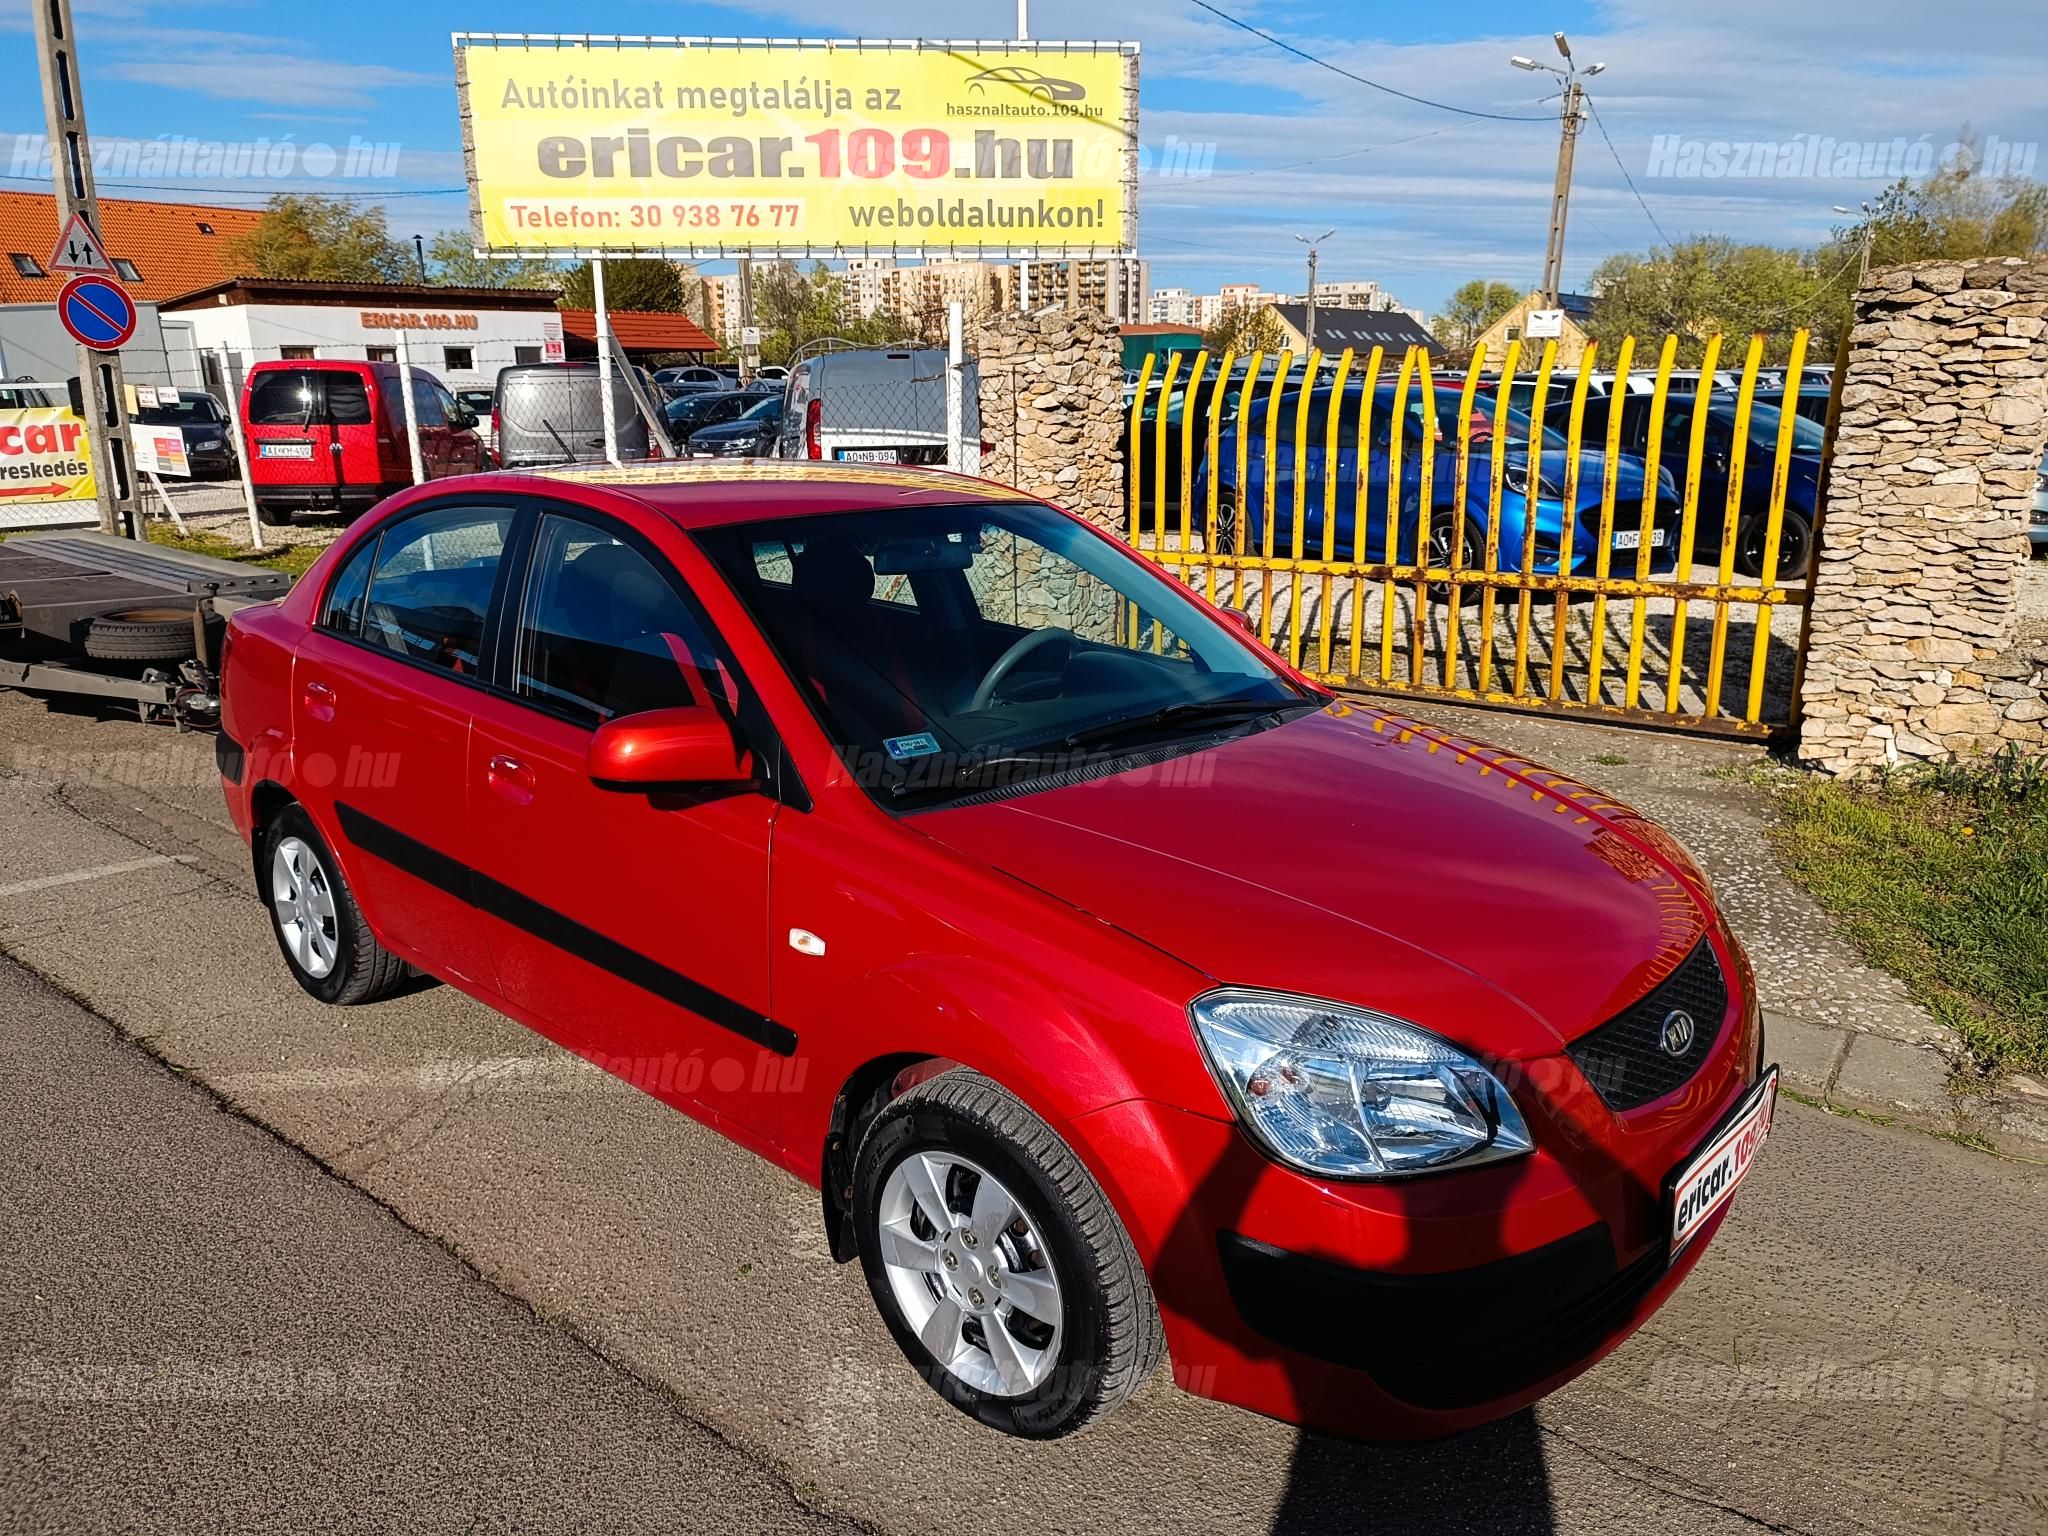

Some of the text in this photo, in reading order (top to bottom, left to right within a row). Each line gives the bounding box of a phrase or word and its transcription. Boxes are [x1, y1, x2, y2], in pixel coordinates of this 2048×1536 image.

[501, 75, 902, 118] Autóinkat megtalálja az
[946, 103, 1104, 117] hasznaltauto.109.hu
[537, 128, 1074, 180] ericar.109.hu
[510, 205, 799, 228] Telefon: 30 938 76 77
[849, 198, 1104, 228] weboldalunkon!
